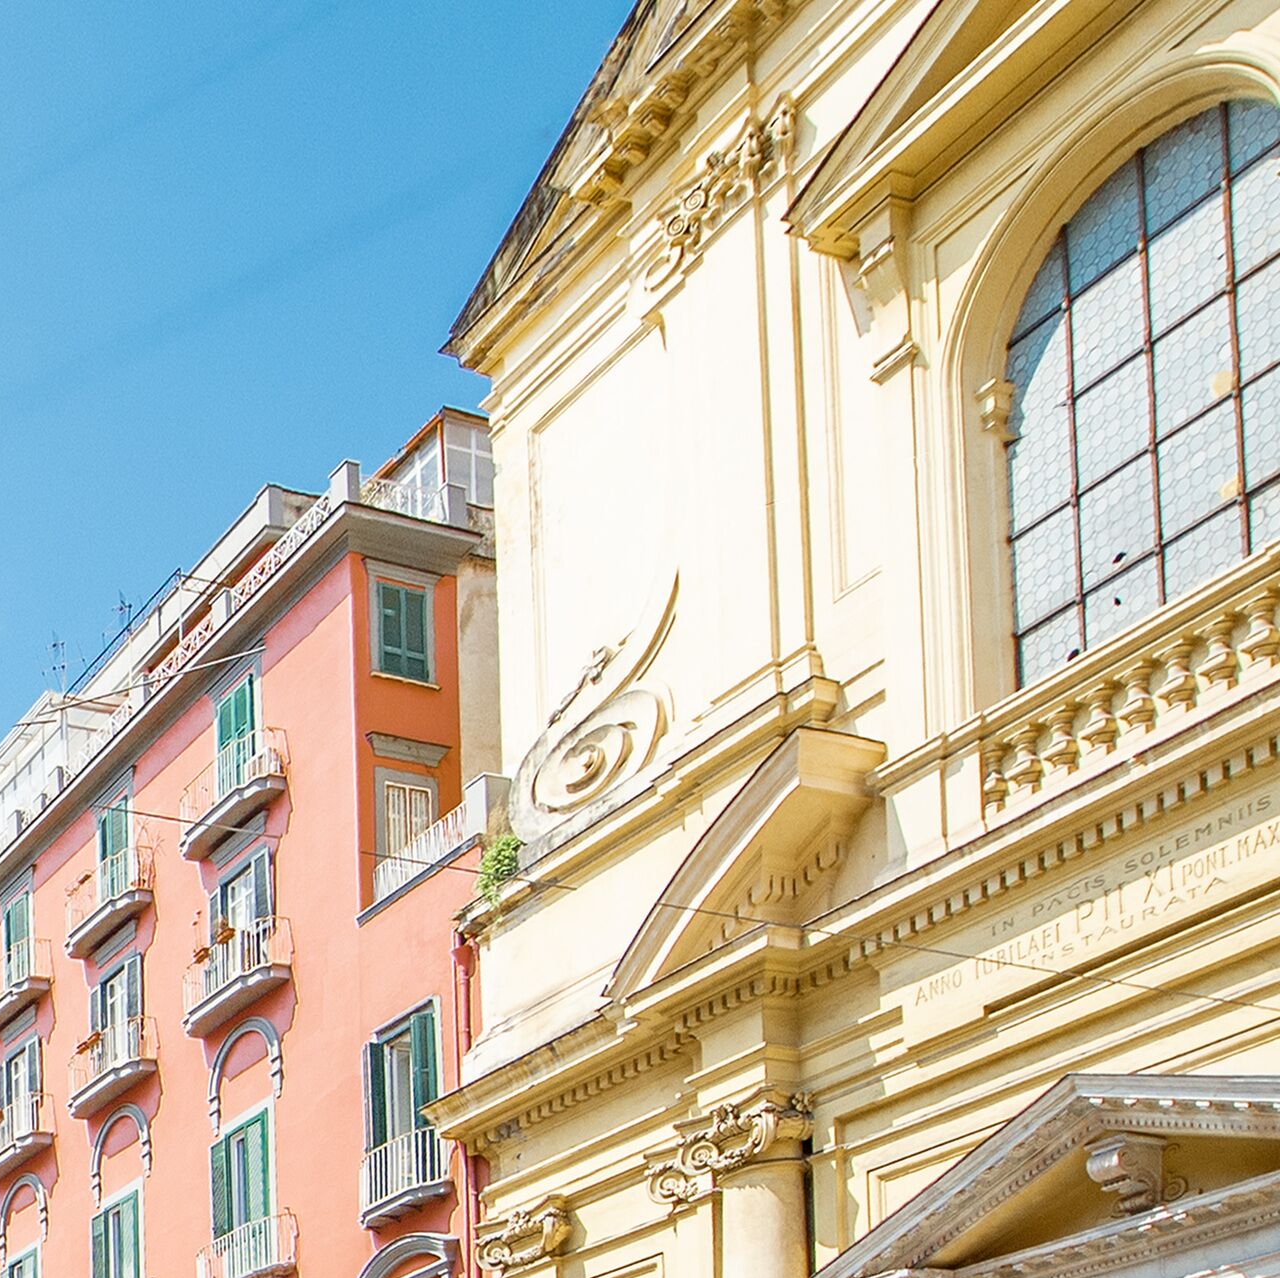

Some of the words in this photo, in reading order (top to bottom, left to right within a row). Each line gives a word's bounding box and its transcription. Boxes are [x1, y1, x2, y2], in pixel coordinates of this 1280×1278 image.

[916, 969, 962, 1006] ANNO
[1076, 881, 1130, 933] PII
[1144, 859, 1175, 904] XI
[992, 918, 1014, 936] IN
[1032, 874, 1105, 917] PACIS
[1125, 794, 1271, 874] SOLEMNIIS
[1031, 877, 1226, 968] INSTAURATA
